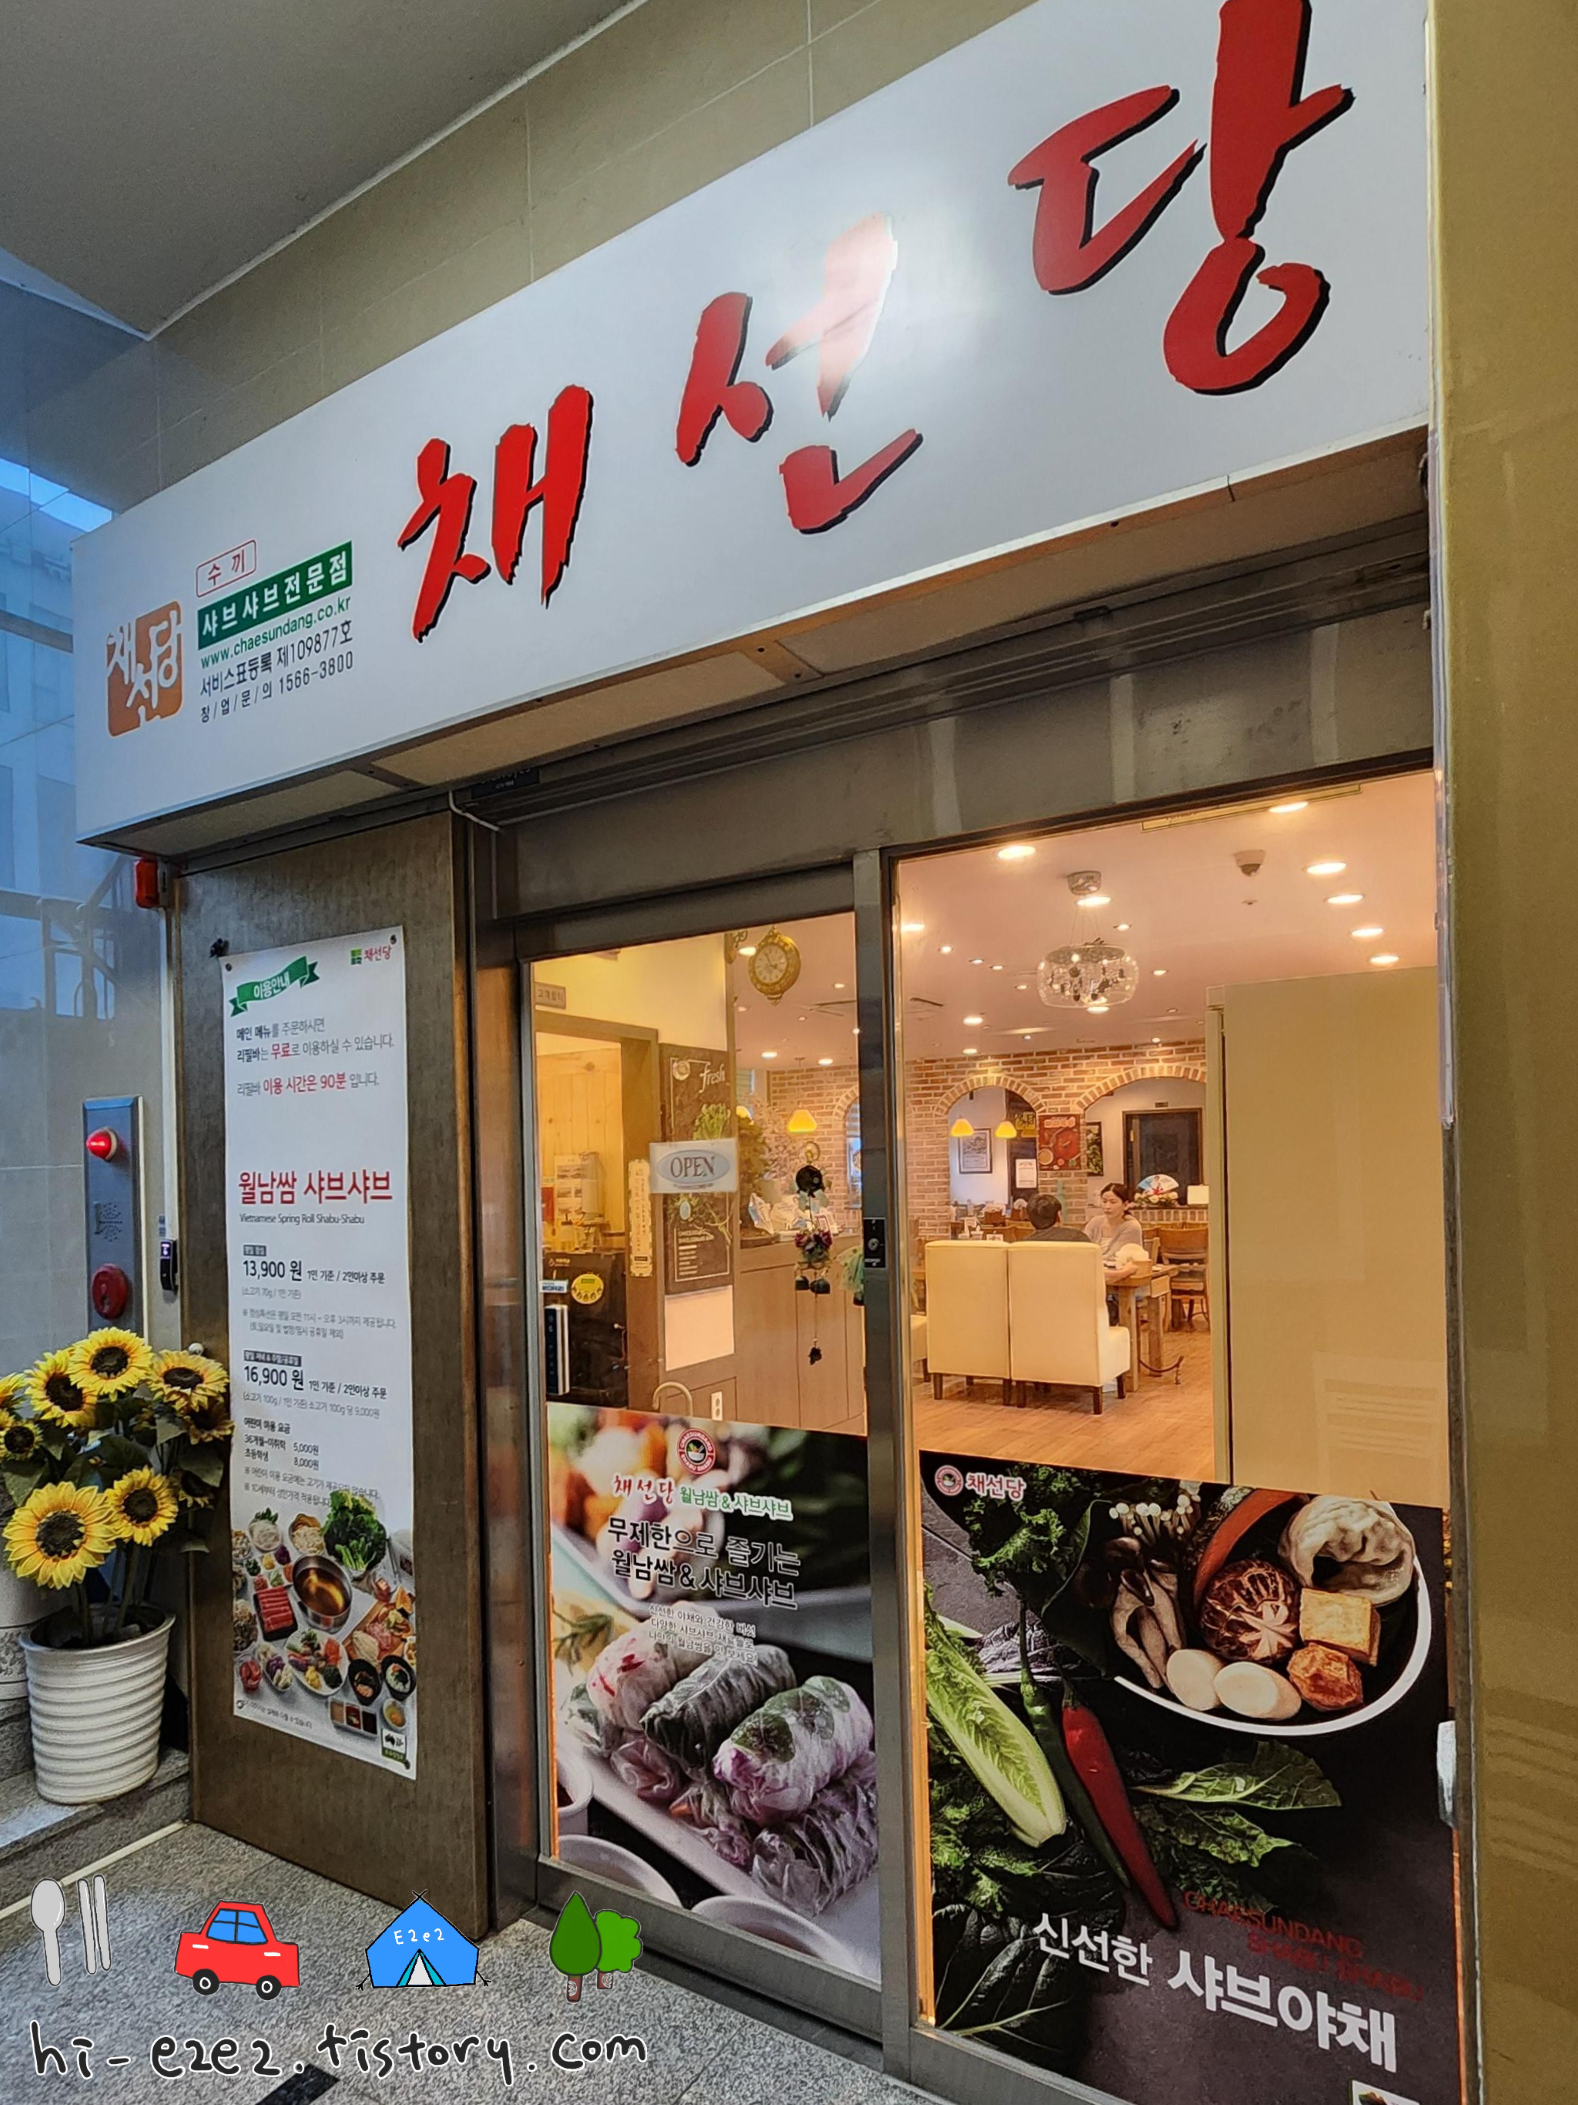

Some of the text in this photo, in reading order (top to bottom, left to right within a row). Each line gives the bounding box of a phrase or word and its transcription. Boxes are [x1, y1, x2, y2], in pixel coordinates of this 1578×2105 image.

[202, 551, 347, 637] 샤브샤브전문점
[201, 596, 351, 669] www.chaesundang.co.kr
[200, 620, 353, 698] 서비스표등록 제109877호
[278, 650, 353, 695] 1566-3800
[364, 945, 392, 962] 채선당
[253, 971, 290, 999] 이용안내
[236, 1017, 325, 1041] 메인 메뉴를 주문하시면
[237, 1034, 395, 1063] 리필바는 무료로 이용하실 수 있습니다.
[237, 1071, 379, 1097] 리필바 이용 시간은 90분 입니다.
[698, 1063, 725, 1094] fresh
[670, 1156, 715, 1178] OPEN
[238, 1169, 393, 1205] 월남쌈 샤브샤브
[239, 1213, 365, 1225] Vietnamese Spring Roll Shabu-Shabu
[243, 1260, 285, 1280] 13,900
[289, 1260, 302, 1281] 원
[306, 1270, 318, 1281] 1인
[320, 1271, 335, 1282] 기준
[369, 1272, 386, 1284] 주문
[244, 1366, 287, 1387] 16,900
[291, 1369, 304, 1391] 원
[309, 1380, 319, 1392] 1인
[321, 1381, 336, 1394] 기준
[343, 1383, 370, 1398] 2인이상
[371, 1387, 388, 1400] 주문
[614, 1475, 792, 1518] 채선당 월남쌈 & 샤브샤브
[966, 1473, 1026, 1500] 채선당
[608, 1516, 801, 1576] 무제한으로 즐기는
[612, 1549, 798, 1609] 월남쌈 & 샤브샤브
[648, 1603, 674, 1618] 신선한
[677, 1611, 703, 1625] 야채와
[707, 1616, 734, 1633] 건강한
[651, 1618, 677, 1631] 다양한
[1183, 1890, 1363, 1959] CHAESUNDANG
[1033, 1912, 1397, 2073] 신선한 샤브야채
